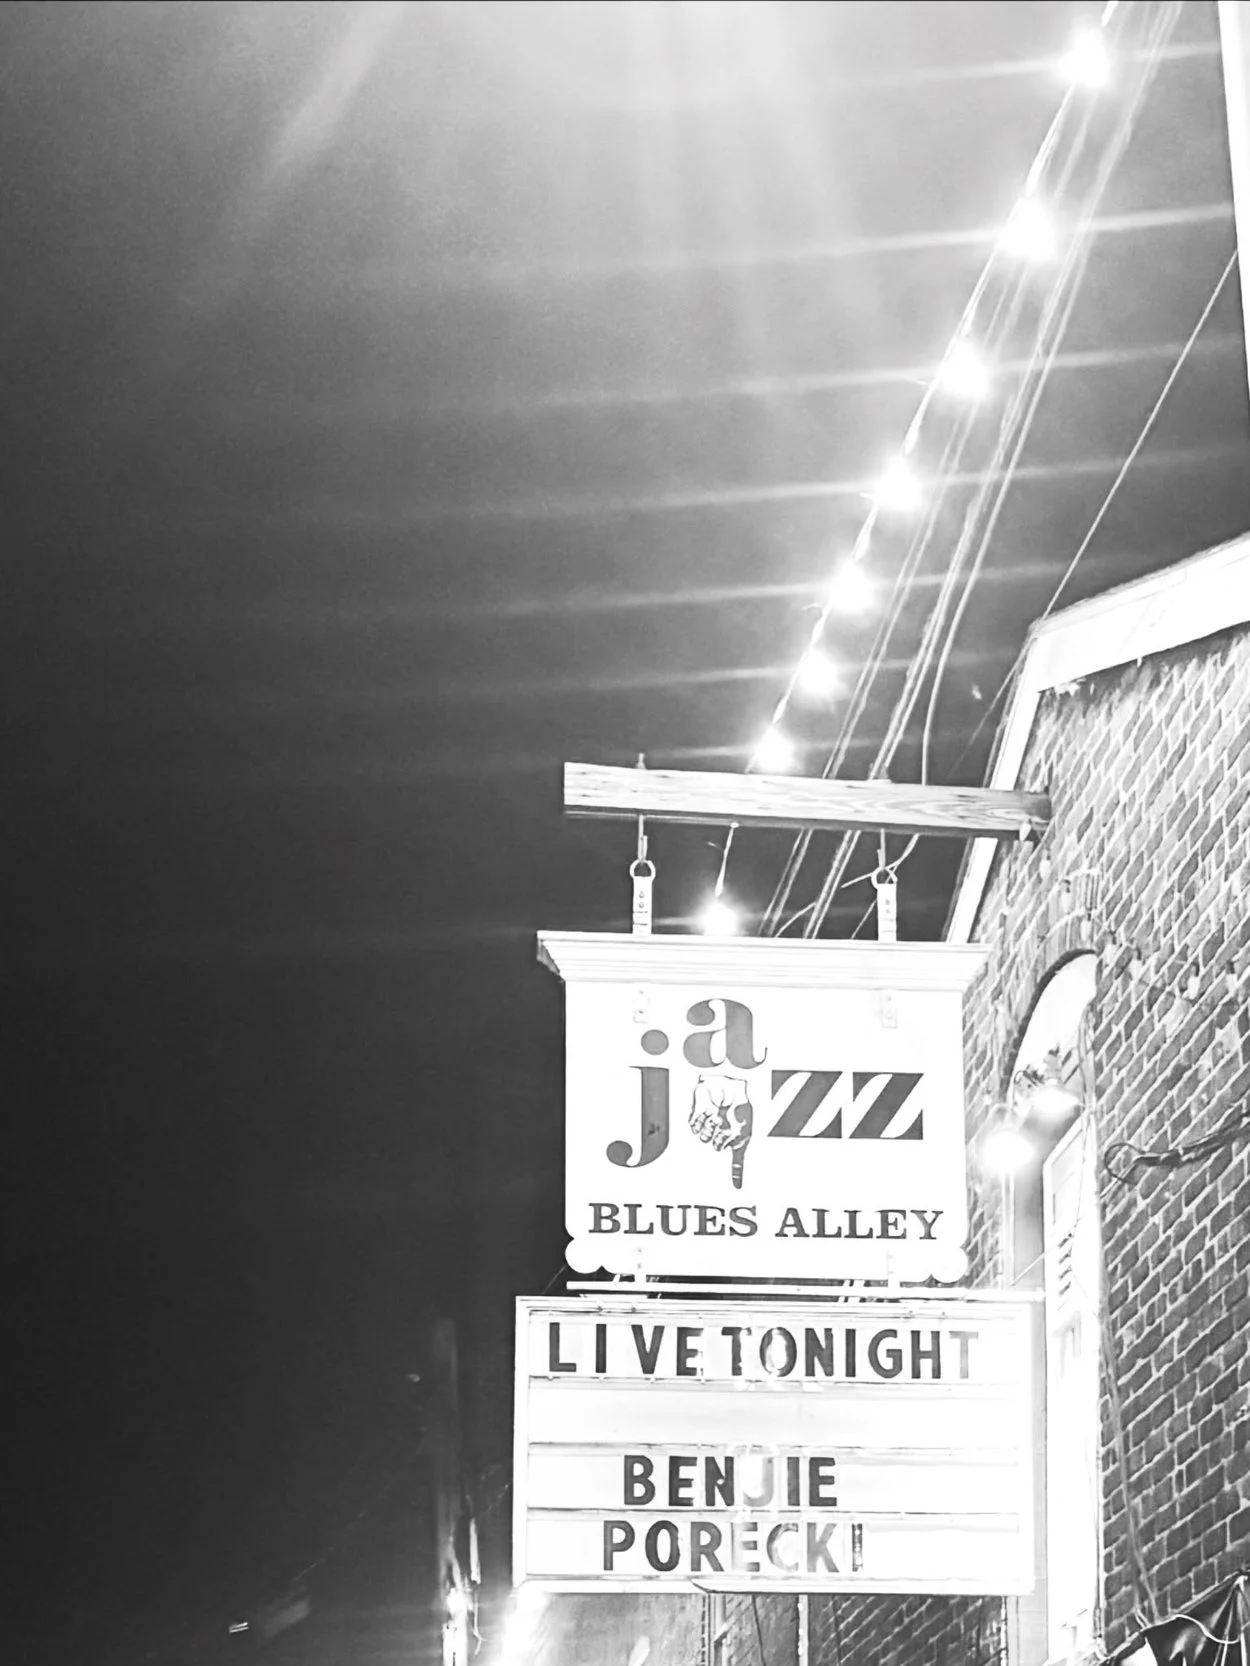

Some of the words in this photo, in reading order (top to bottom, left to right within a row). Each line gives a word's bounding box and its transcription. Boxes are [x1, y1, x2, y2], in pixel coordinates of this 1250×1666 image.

[607, 998, 924, 1168] jazz
[588, 1202, 757, 1238] BLUES
[775, 1207, 943, 1240] ALLEY
[549, 1322, 704, 1377] LIVE
[721, 1326, 979, 1379] TONIGHT
[623, 1454, 838, 1507] BENJIE
[603, 1519, 864, 1573] PORECKI
